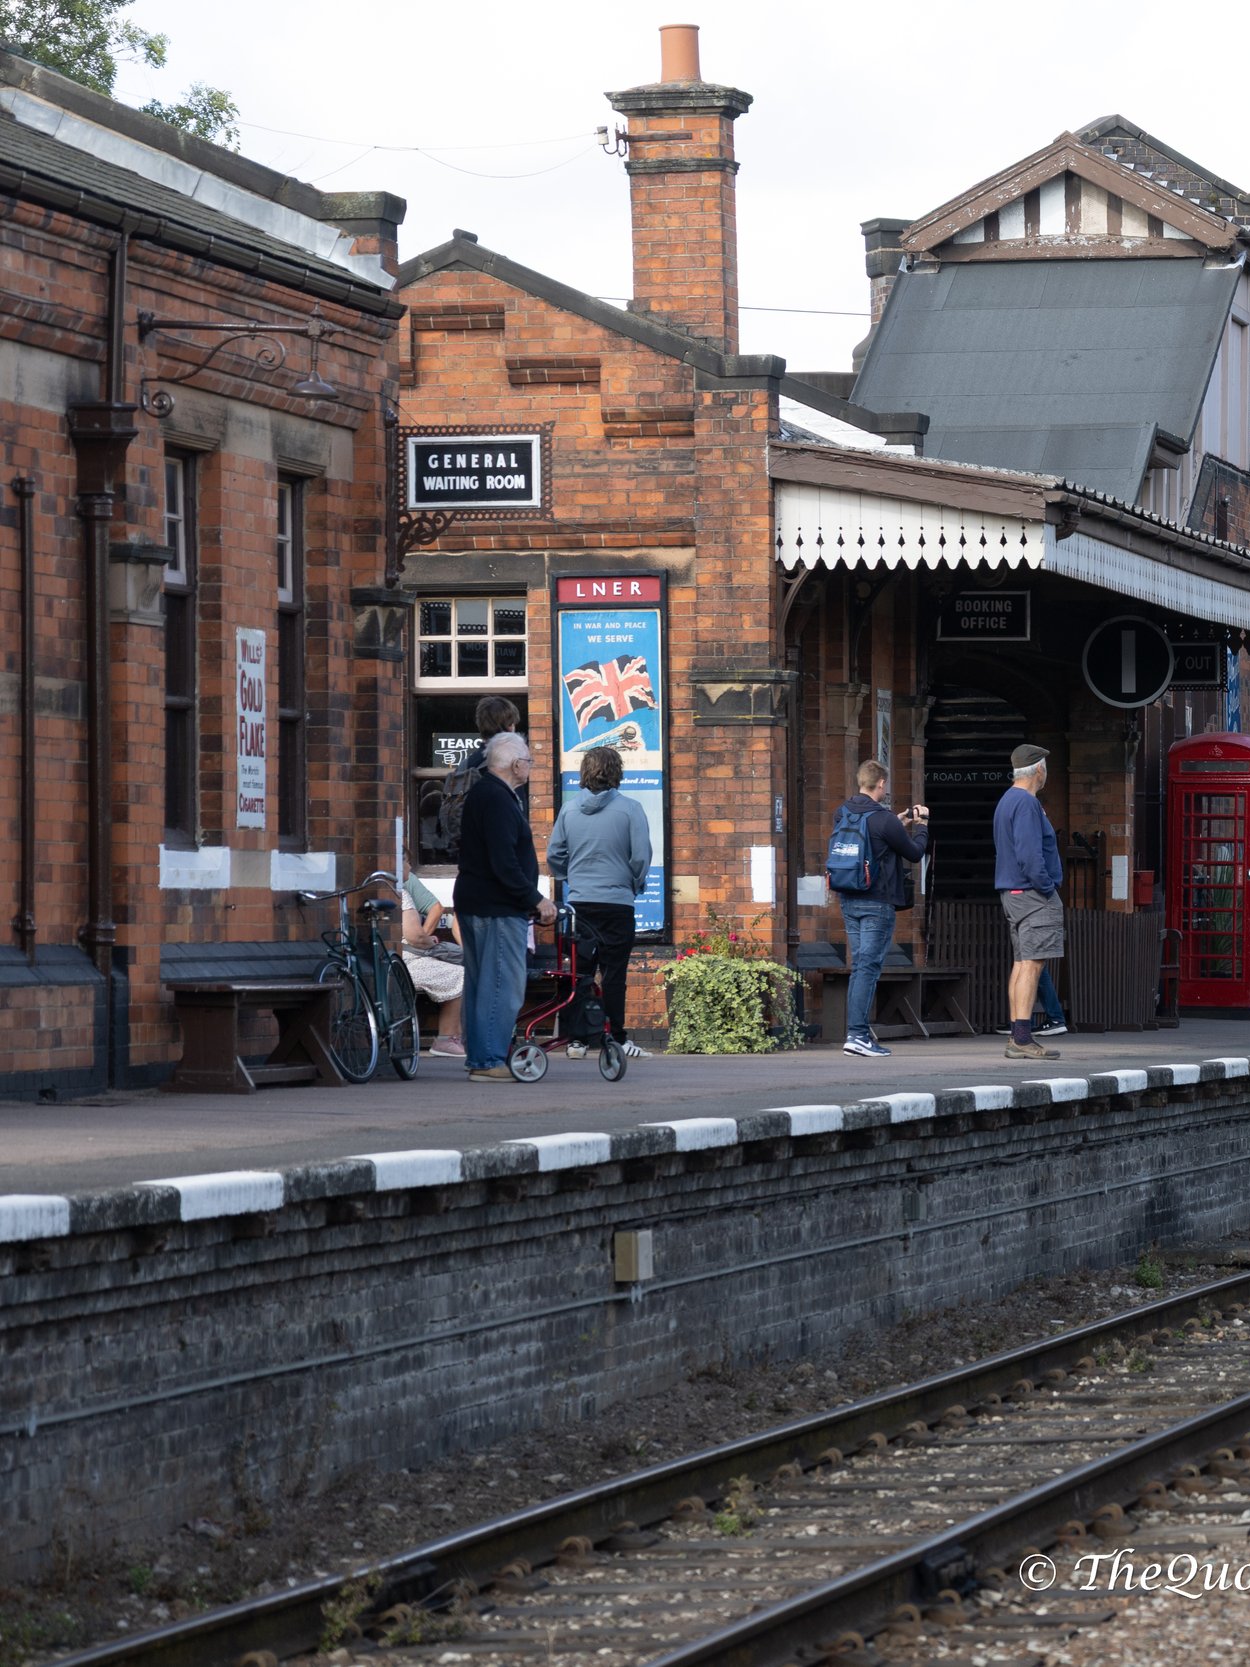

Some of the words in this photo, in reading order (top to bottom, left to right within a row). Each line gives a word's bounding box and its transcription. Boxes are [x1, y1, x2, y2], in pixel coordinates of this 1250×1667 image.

[428, 453, 518, 469] GENERAL
[423, 476, 479, 491] WAITING
[486, 474, 526, 490] ROOM
[576, 581, 642, 597] LNER
[955, 600, 1012, 612] BOOKING
[624, 621, 647, 629] PEACE
[961, 617, 1007, 629] OFFICE
[587, 635, 602, 643] WE
[605, 634, 634, 643] SERVE
[1184, 656, 1212, 670] OUT
[438, 738, 483, 749] TEARO
[933, 772, 962, 781] ROAD
[964, 772, 977, 781] AT
[982, 772, 1003, 781] TOP
[239, 792, 264, 813] CIGARETTE
